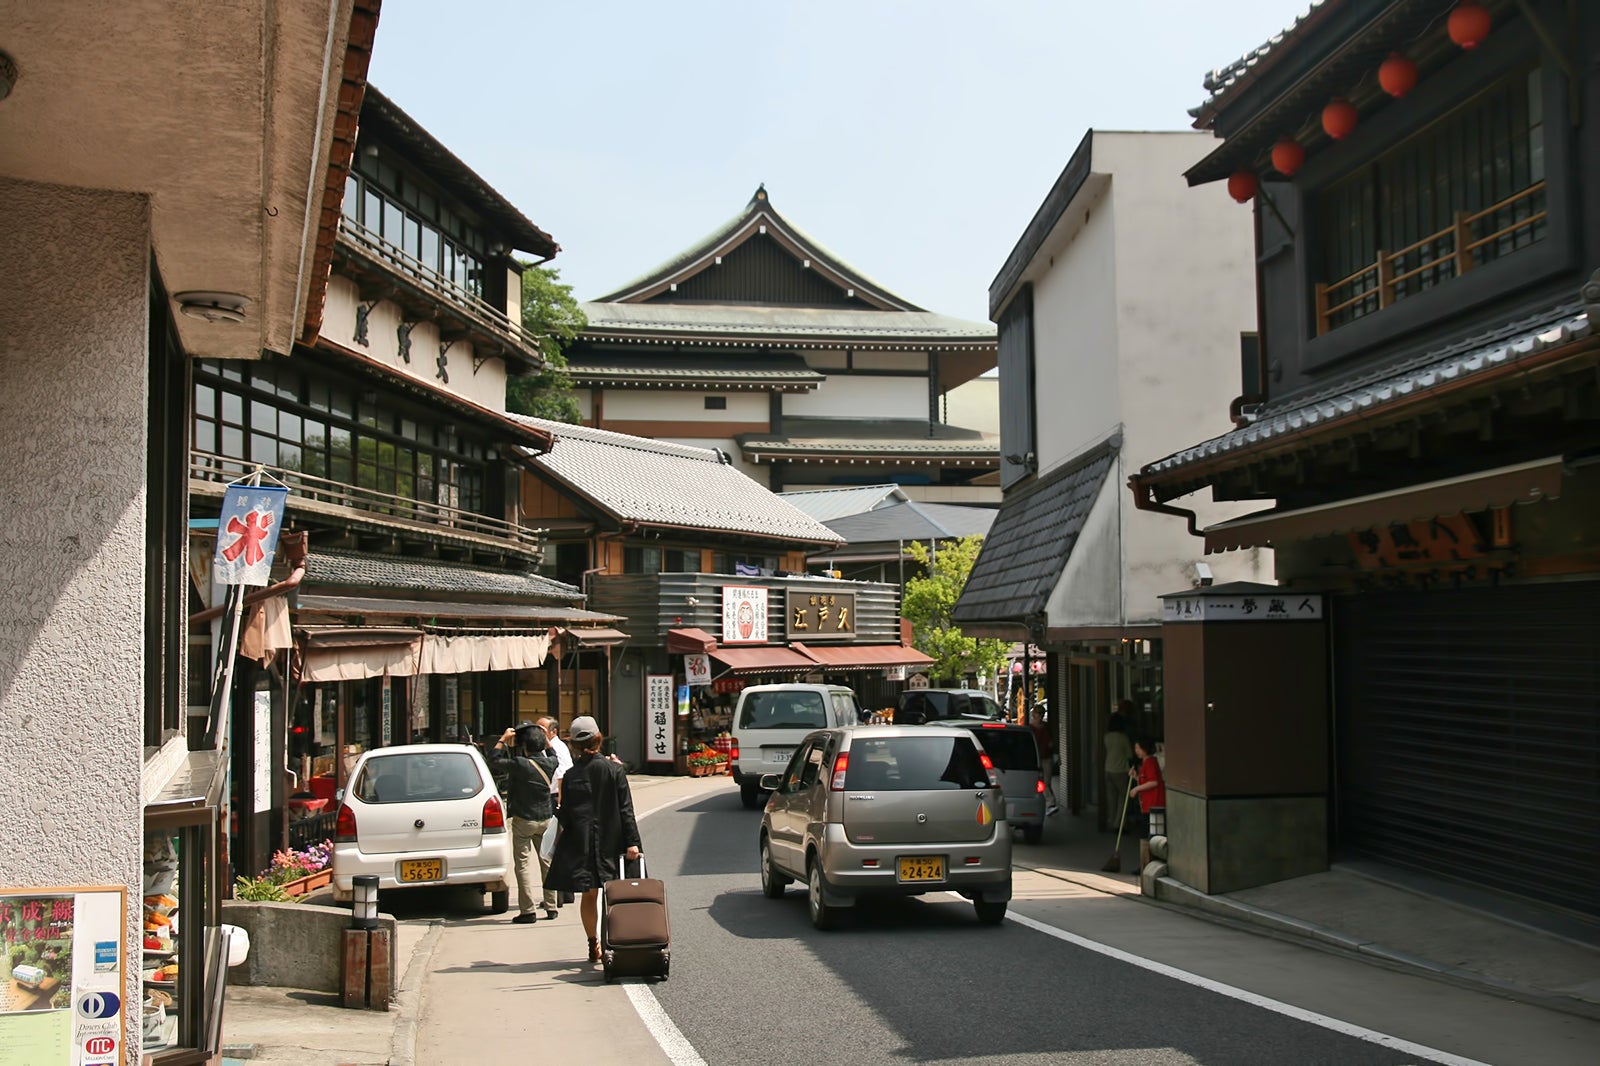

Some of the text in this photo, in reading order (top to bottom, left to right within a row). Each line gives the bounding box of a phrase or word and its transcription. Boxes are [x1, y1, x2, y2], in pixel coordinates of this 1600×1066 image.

[222, 510, 274, 566] 氷
[794, 606, 851, 630] 江戸久
[654, 711, 667, 754] 福よせ
[409, 867, 440, 880] 56-57
[909, 866, 941, 879] 24-24
[79, 1021, 118, 1032] Diners Club
